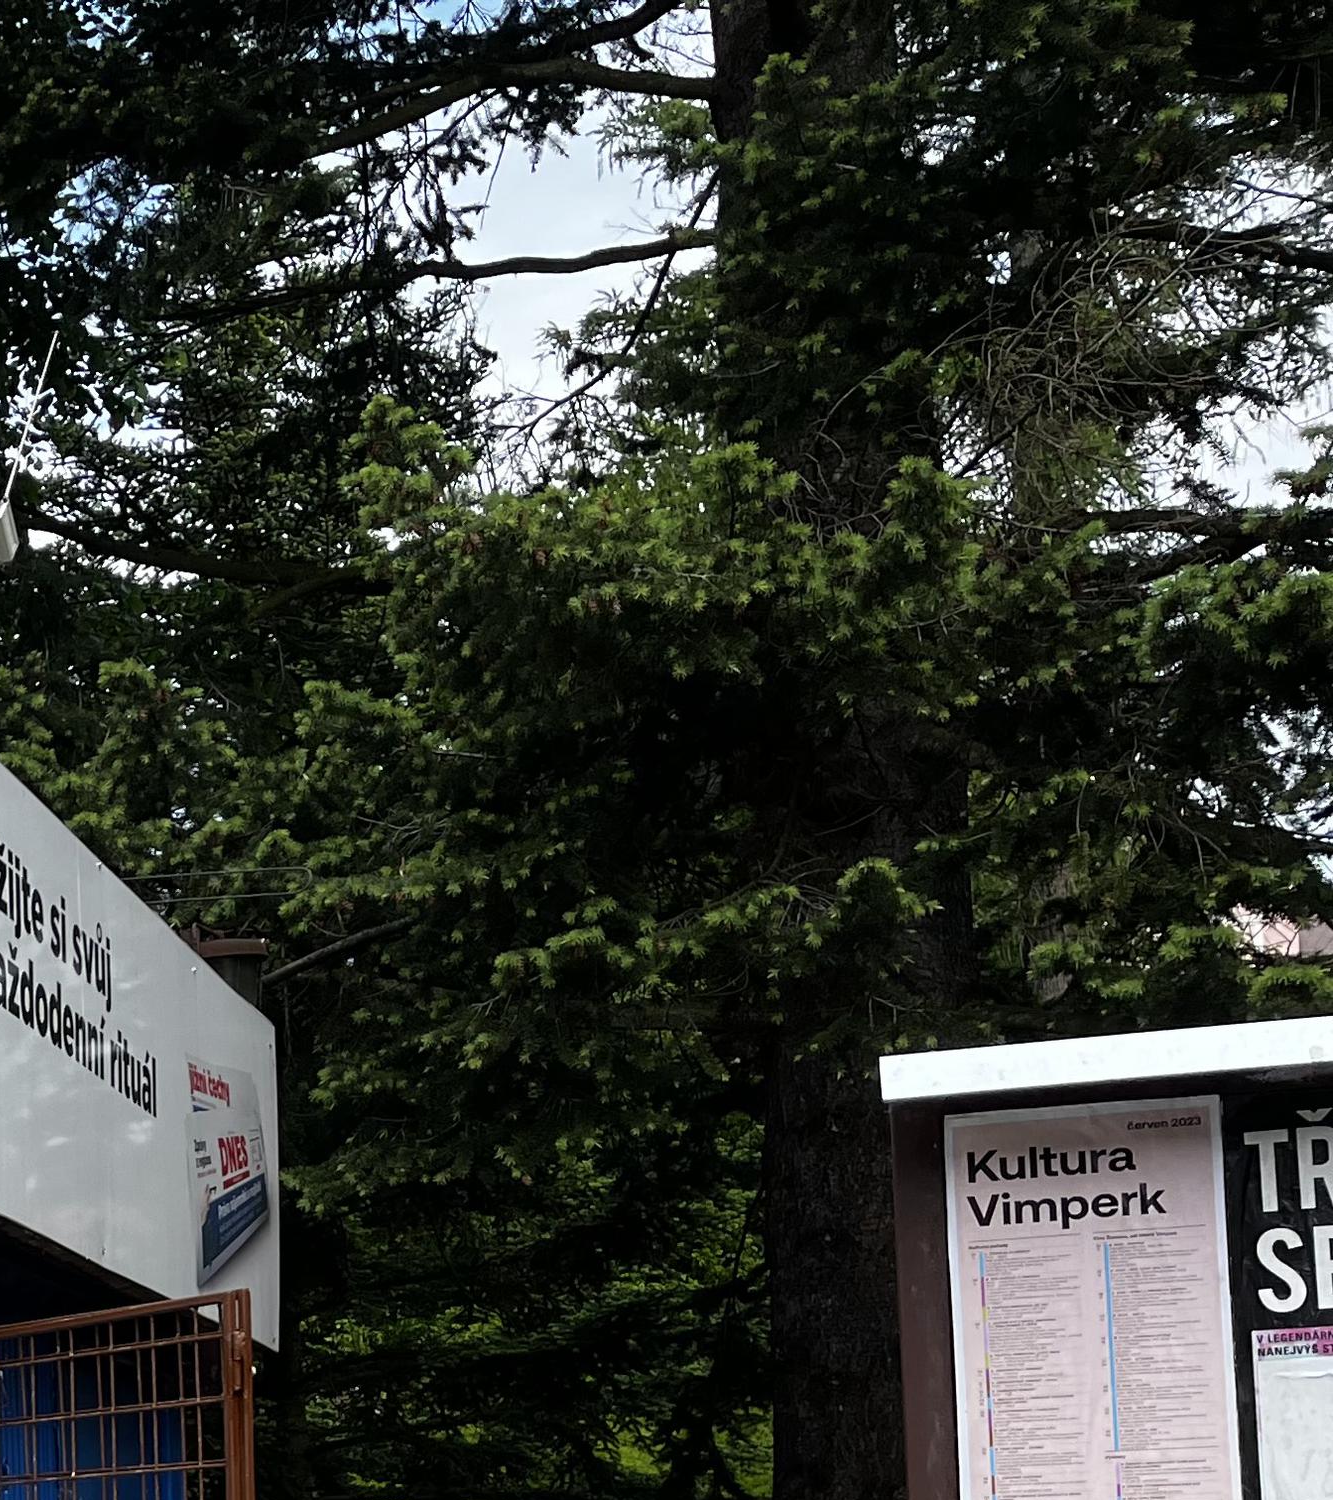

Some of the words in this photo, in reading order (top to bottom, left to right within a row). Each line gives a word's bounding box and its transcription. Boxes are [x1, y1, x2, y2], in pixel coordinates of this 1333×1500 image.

[51, 895, 66, 963] si
[73, 922, 112, 1012] svůj
[109, 1030, 157, 1118] rituál
[1127, 1119, 1169, 1130] červen
[1171, 1116, 1201, 1128] 2023
[218, 1135, 249, 1177] DNES
[966, 1146, 1136, 1183] Kultura
[967, 1183, 1167, 1230] Vimperk
[1256, 1334, 1265, 1342] V
[1258, 1343, 1319, 1356] NANEJVÝŠ
